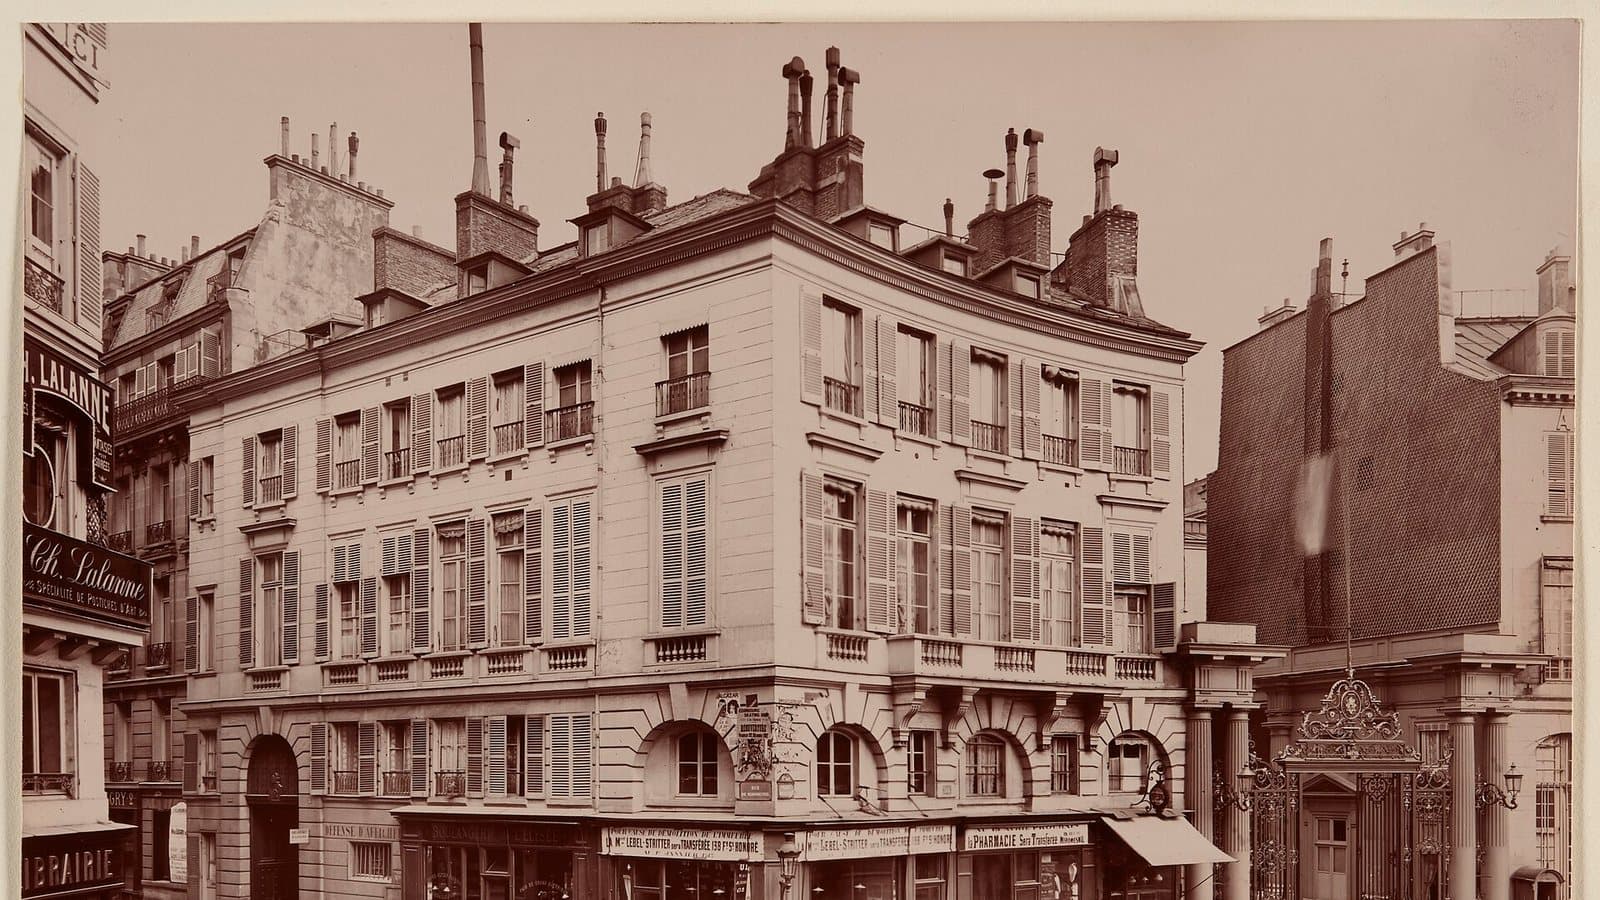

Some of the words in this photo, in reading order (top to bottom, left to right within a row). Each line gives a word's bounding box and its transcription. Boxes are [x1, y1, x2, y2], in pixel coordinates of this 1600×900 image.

[40, 353, 110, 436] LALANNE
[26, 534, 62, 579] Ch.
[67, 547, 144, 600] Lalanne
[76, 591, 85, 603] DE
[974, 833, 1017, 849] PHARMACIE
